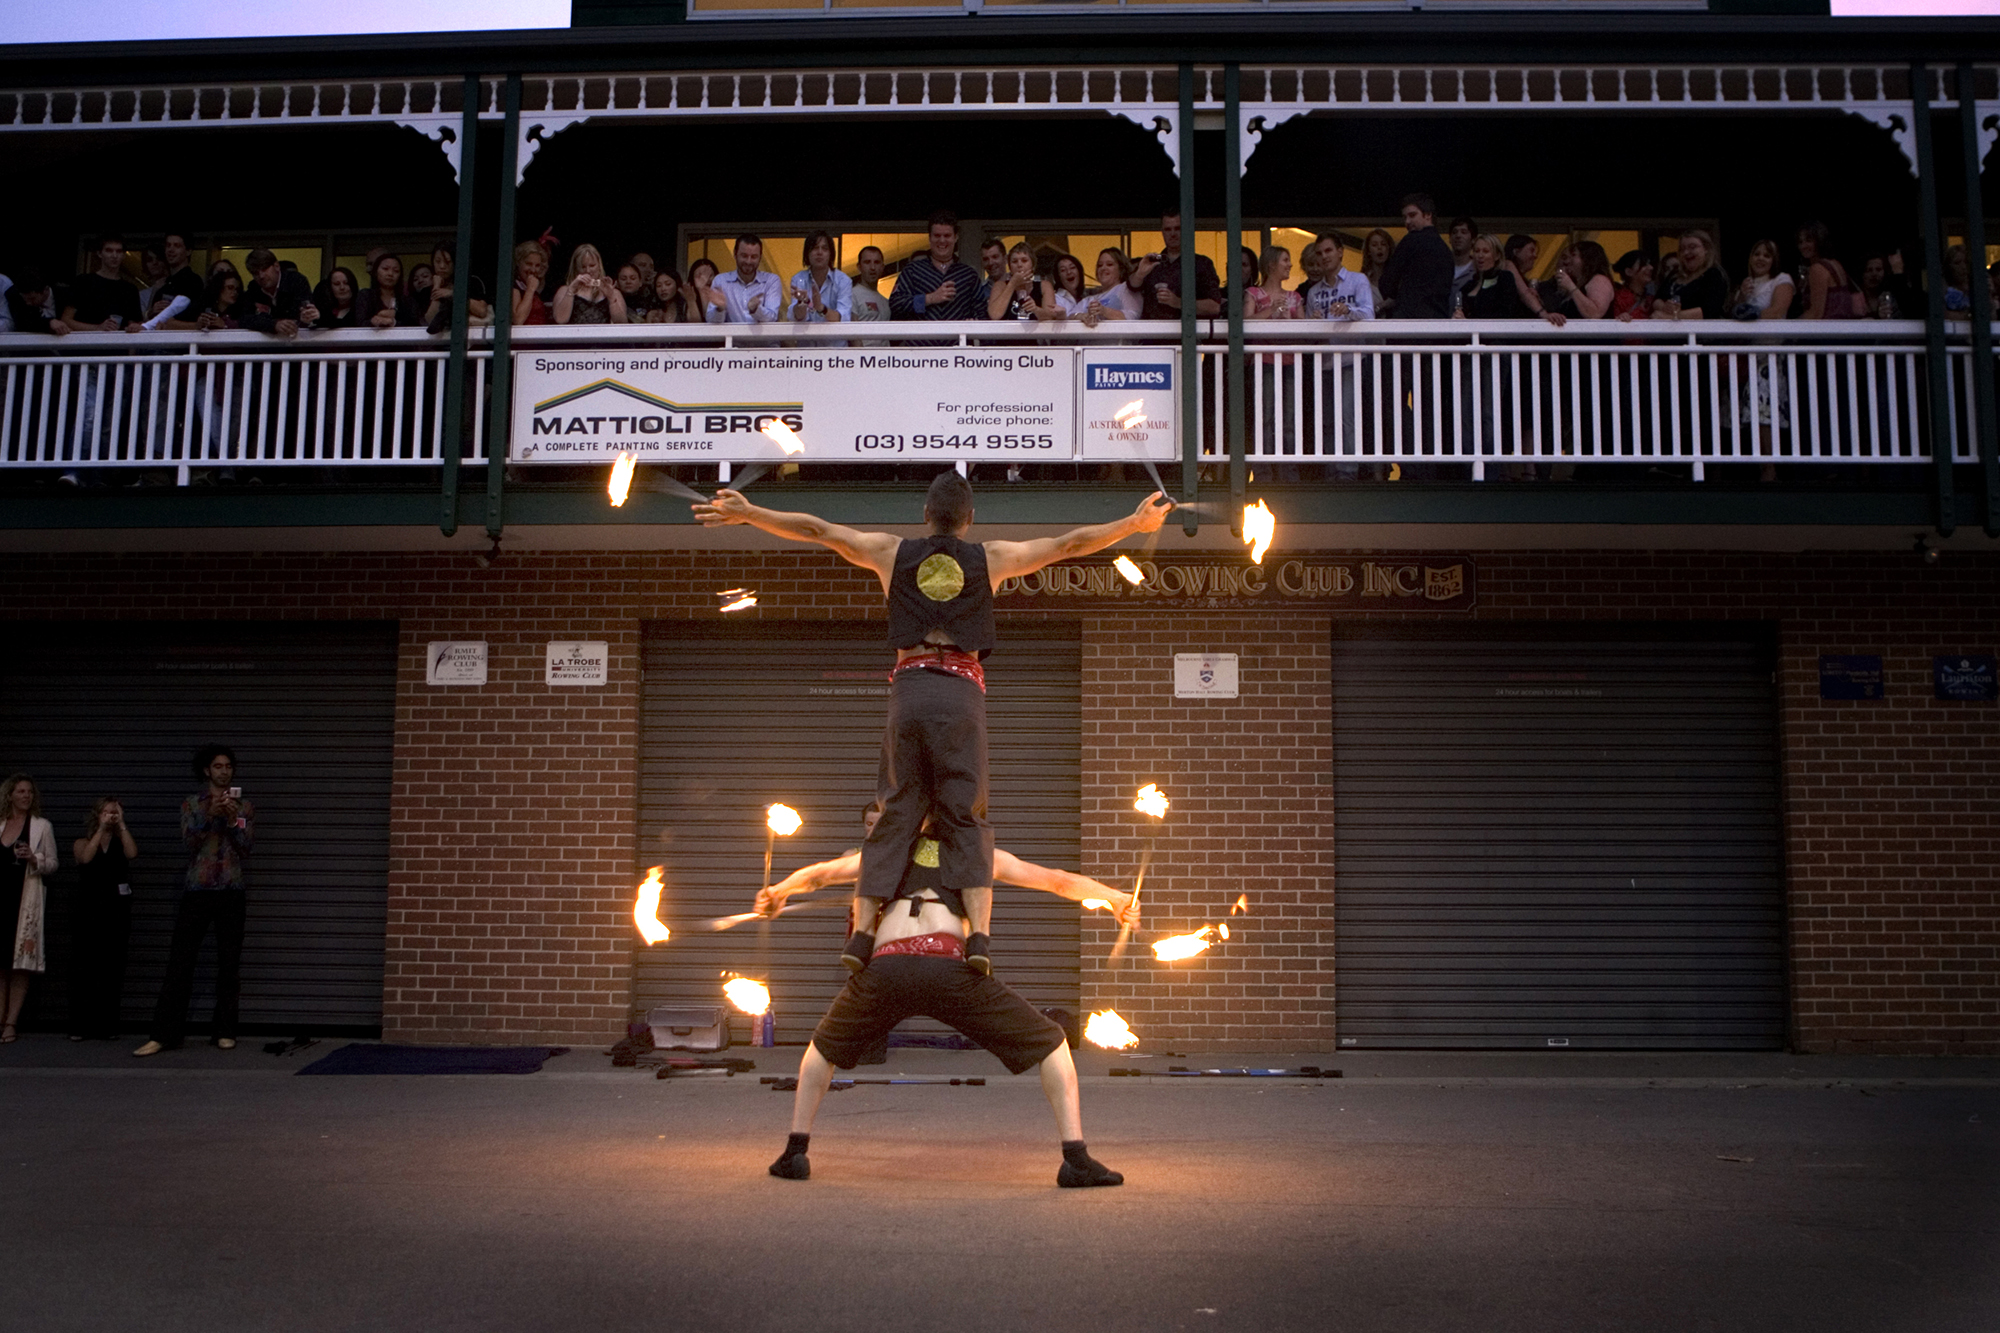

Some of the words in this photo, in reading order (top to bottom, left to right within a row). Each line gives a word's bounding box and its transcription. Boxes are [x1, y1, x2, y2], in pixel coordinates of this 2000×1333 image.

[535, 358, 625, 373] Sponsoring
[630, 358, 659, 370] and
[664, 357, 724, 373] proudly
[728, 357, 822, 372] maintaining
[828, 357, 854, 369] the
[860, 356, 949, 369] Melbourne
[954, 356, 1013, 371] Rowing
[1018, 355, 1054, 368] Club
[1094, 368, 1165, 387] Haymes
[937, 402, 961, 412] For
[965, 402, 1054, 415] professional
[532, 415, 692, 435] MATTIOLI
[705, 414, 804, 434] BROS
[957, 415, 1001, 425] advice
[1006, 415, 1053, 427] phone:
[1147, 421, 1170, 429] MADE
[854, 434, 904, 452] (03)
[912, 434, 978, 449] 9544
[986, 434, 1053, 449] 9555
[1108, 432, 1114, 441] &
[1116, 432, 1149, 441] OWNED
[531, 442, 539, 451] A
[545, 442, 599, 451] COMPLETE
[606, 441, 660, 451] PAINTING
[666, 441, 713, 450] SERVICE
[1132, 561, 1268, 595] ROWING
[1278, 560, 1354, 595] CLUB
[1363, 562, 1424, 595] INC.
[1430, 568, 1458, 583] EST.
[1428, 581, 1461, 598] 1862
[567, 658, 601, 666] TROBE
